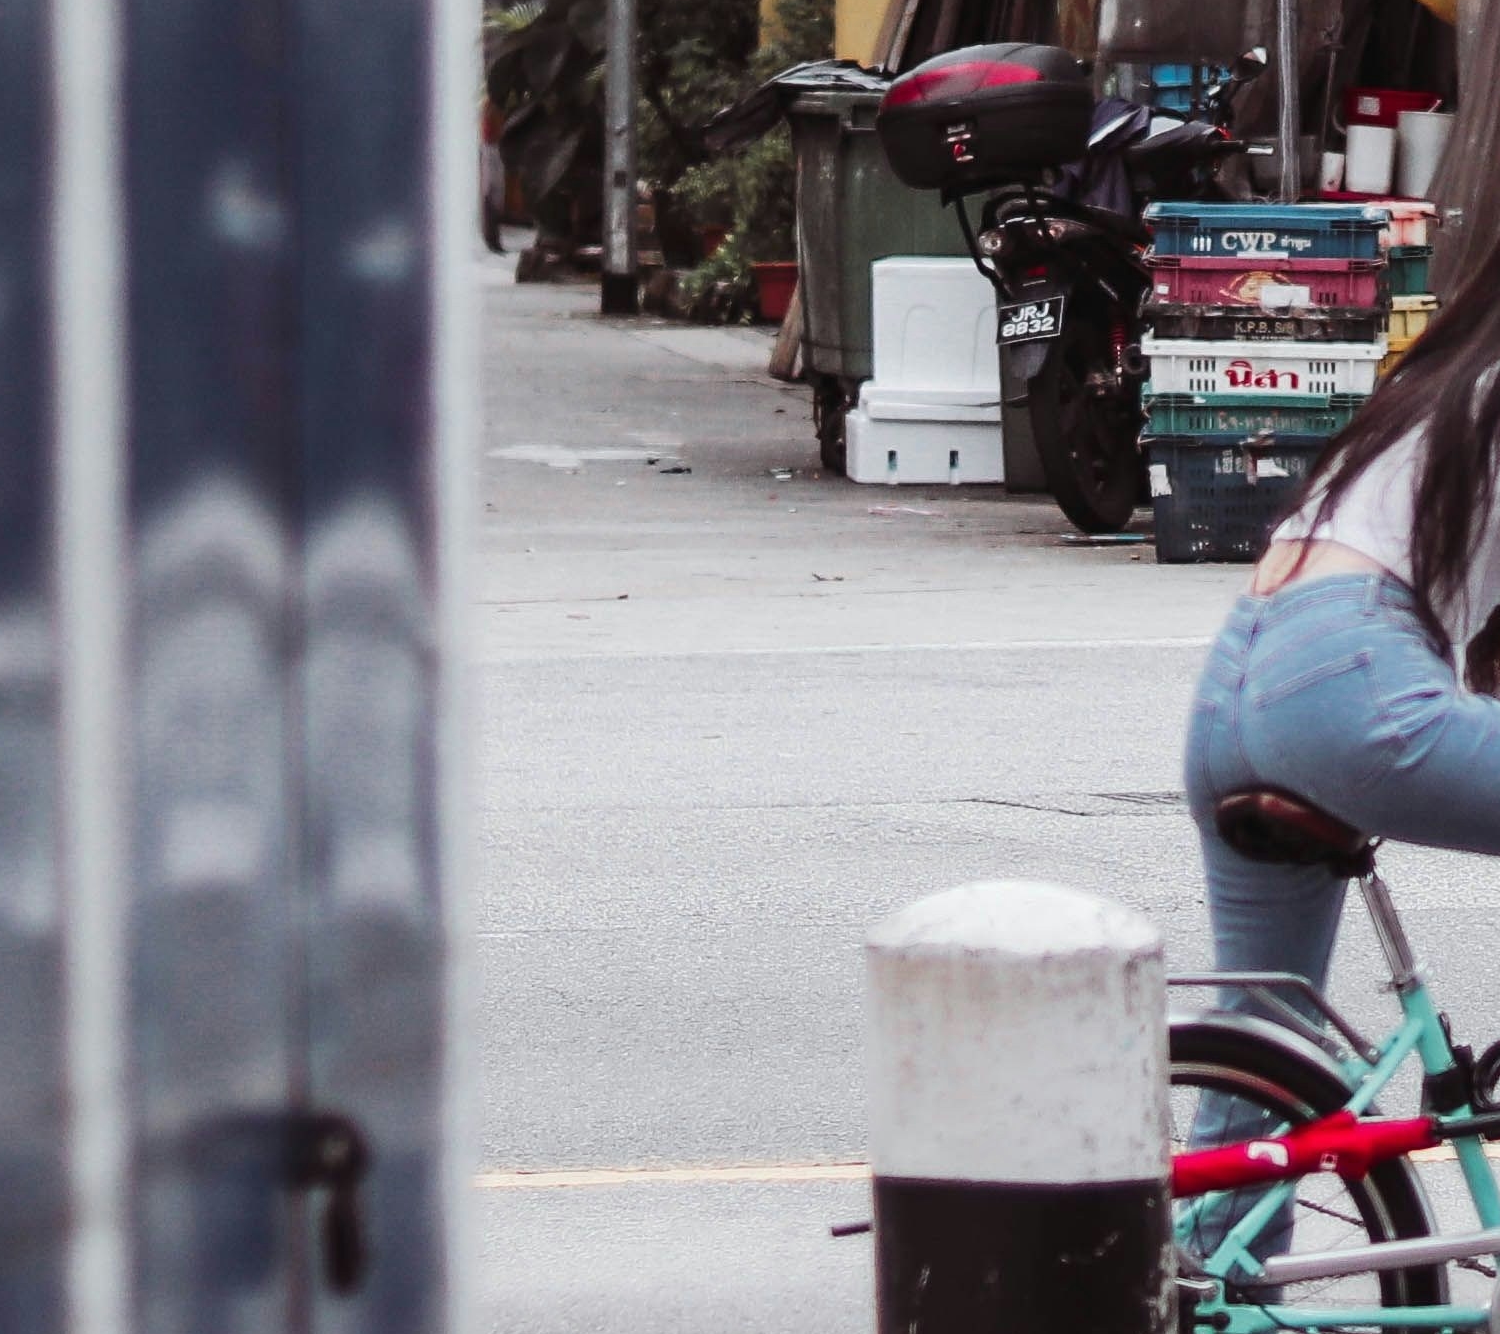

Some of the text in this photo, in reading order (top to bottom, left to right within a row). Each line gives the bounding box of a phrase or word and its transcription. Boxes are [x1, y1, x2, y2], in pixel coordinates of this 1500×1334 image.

[1221, 231, 1277, 252] CWP
[1011, 302, 1050, 323] JRJ
[1002, 317, 1055, 338] 8832
